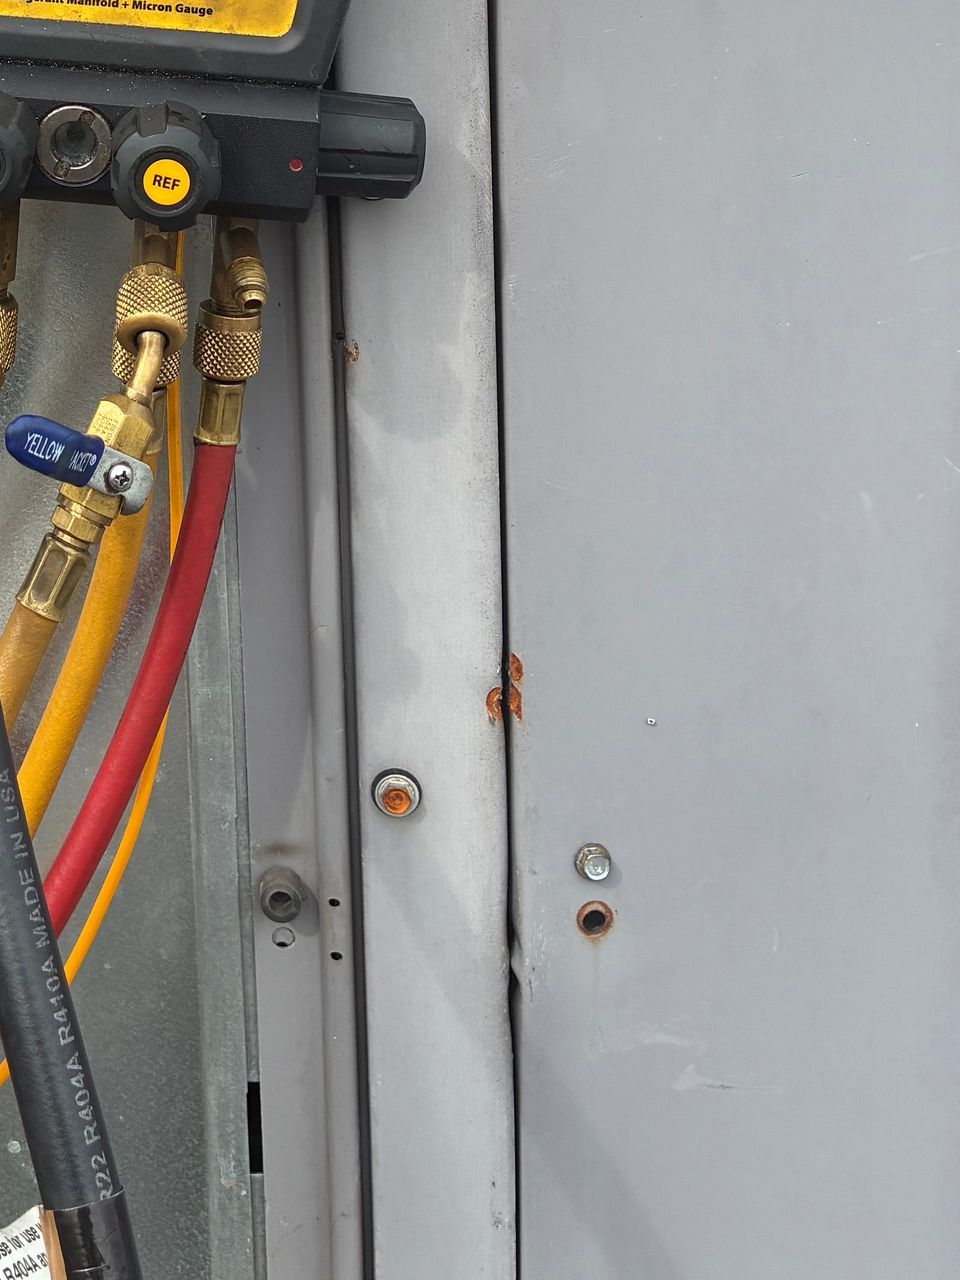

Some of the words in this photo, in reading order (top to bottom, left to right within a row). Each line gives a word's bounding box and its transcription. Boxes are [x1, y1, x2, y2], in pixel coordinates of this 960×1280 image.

[122, 2, 130, 10] +
[132, 0, 172, 12] Micron
[175, 4, 214, 16] Gauge
[152, 174, 180, 191] REF
[24, 432, 66, 463] YELLOW
[10, 832, 28, 860] IN
[19, 868, 50, 950] MADE
[20, 1226, 41, 1244] use
